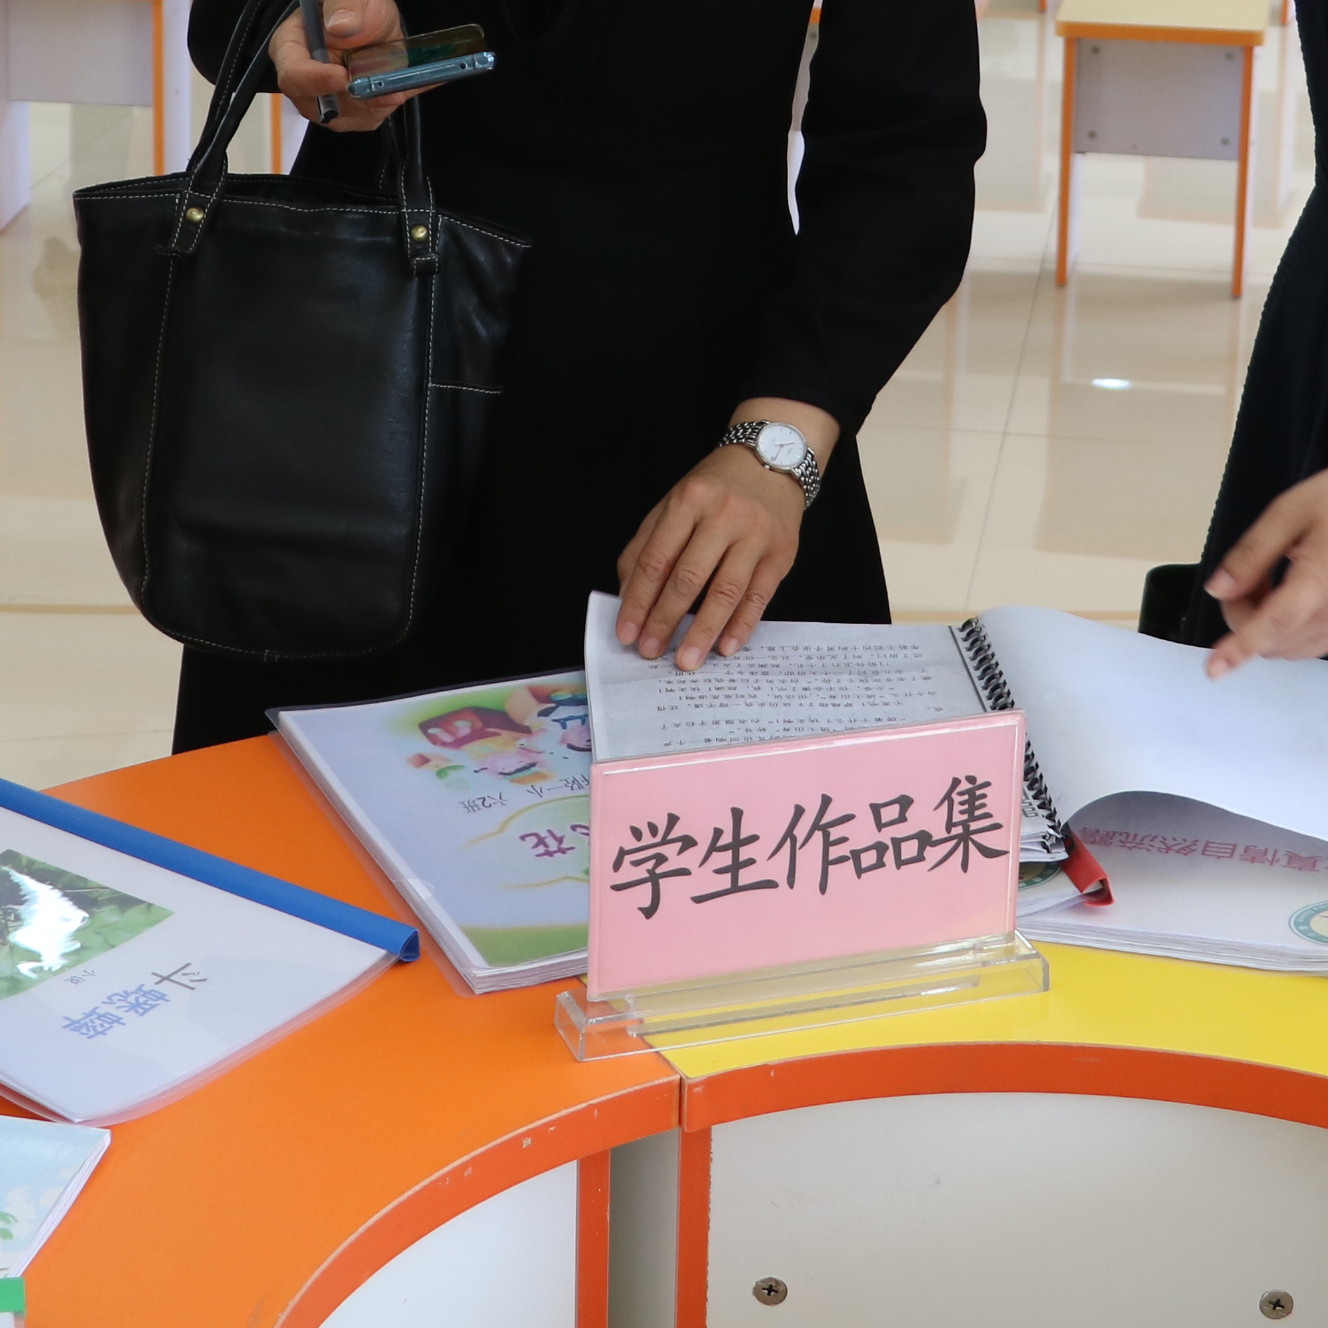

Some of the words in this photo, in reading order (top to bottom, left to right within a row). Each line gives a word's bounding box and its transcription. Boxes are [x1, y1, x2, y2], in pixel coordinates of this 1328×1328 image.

[458, 789, 508, 817] 六2班
[518, 823, 590, 861] 花
[610, 773, 1011, 921] 学生作品集
[59, 960, 206, 1048] 斗蟋蟀
